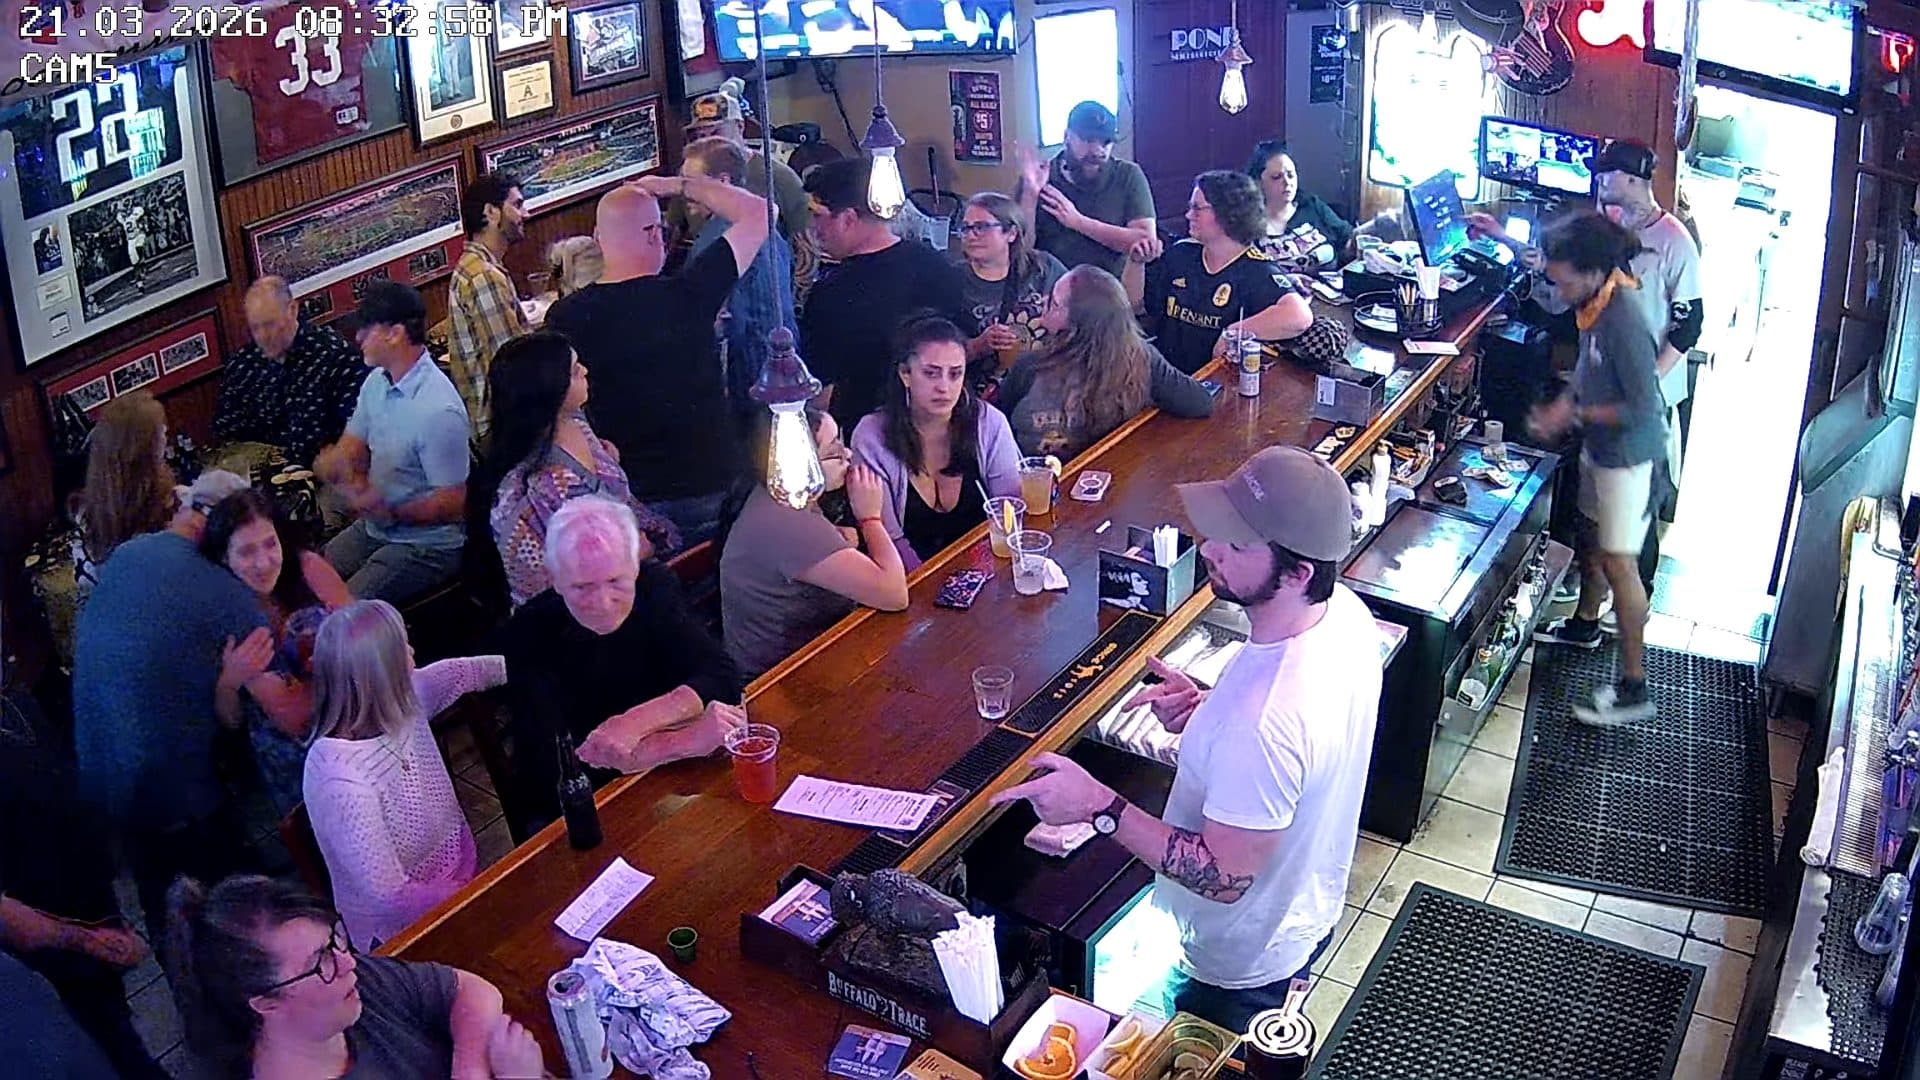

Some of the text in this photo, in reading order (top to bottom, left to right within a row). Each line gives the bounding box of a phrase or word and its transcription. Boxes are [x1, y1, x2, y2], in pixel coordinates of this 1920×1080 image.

[275, 25, 342, 96] 33
[523, 85, 533, 97] A
[828, 970, 928, 1036] BUFFALO TRACE
